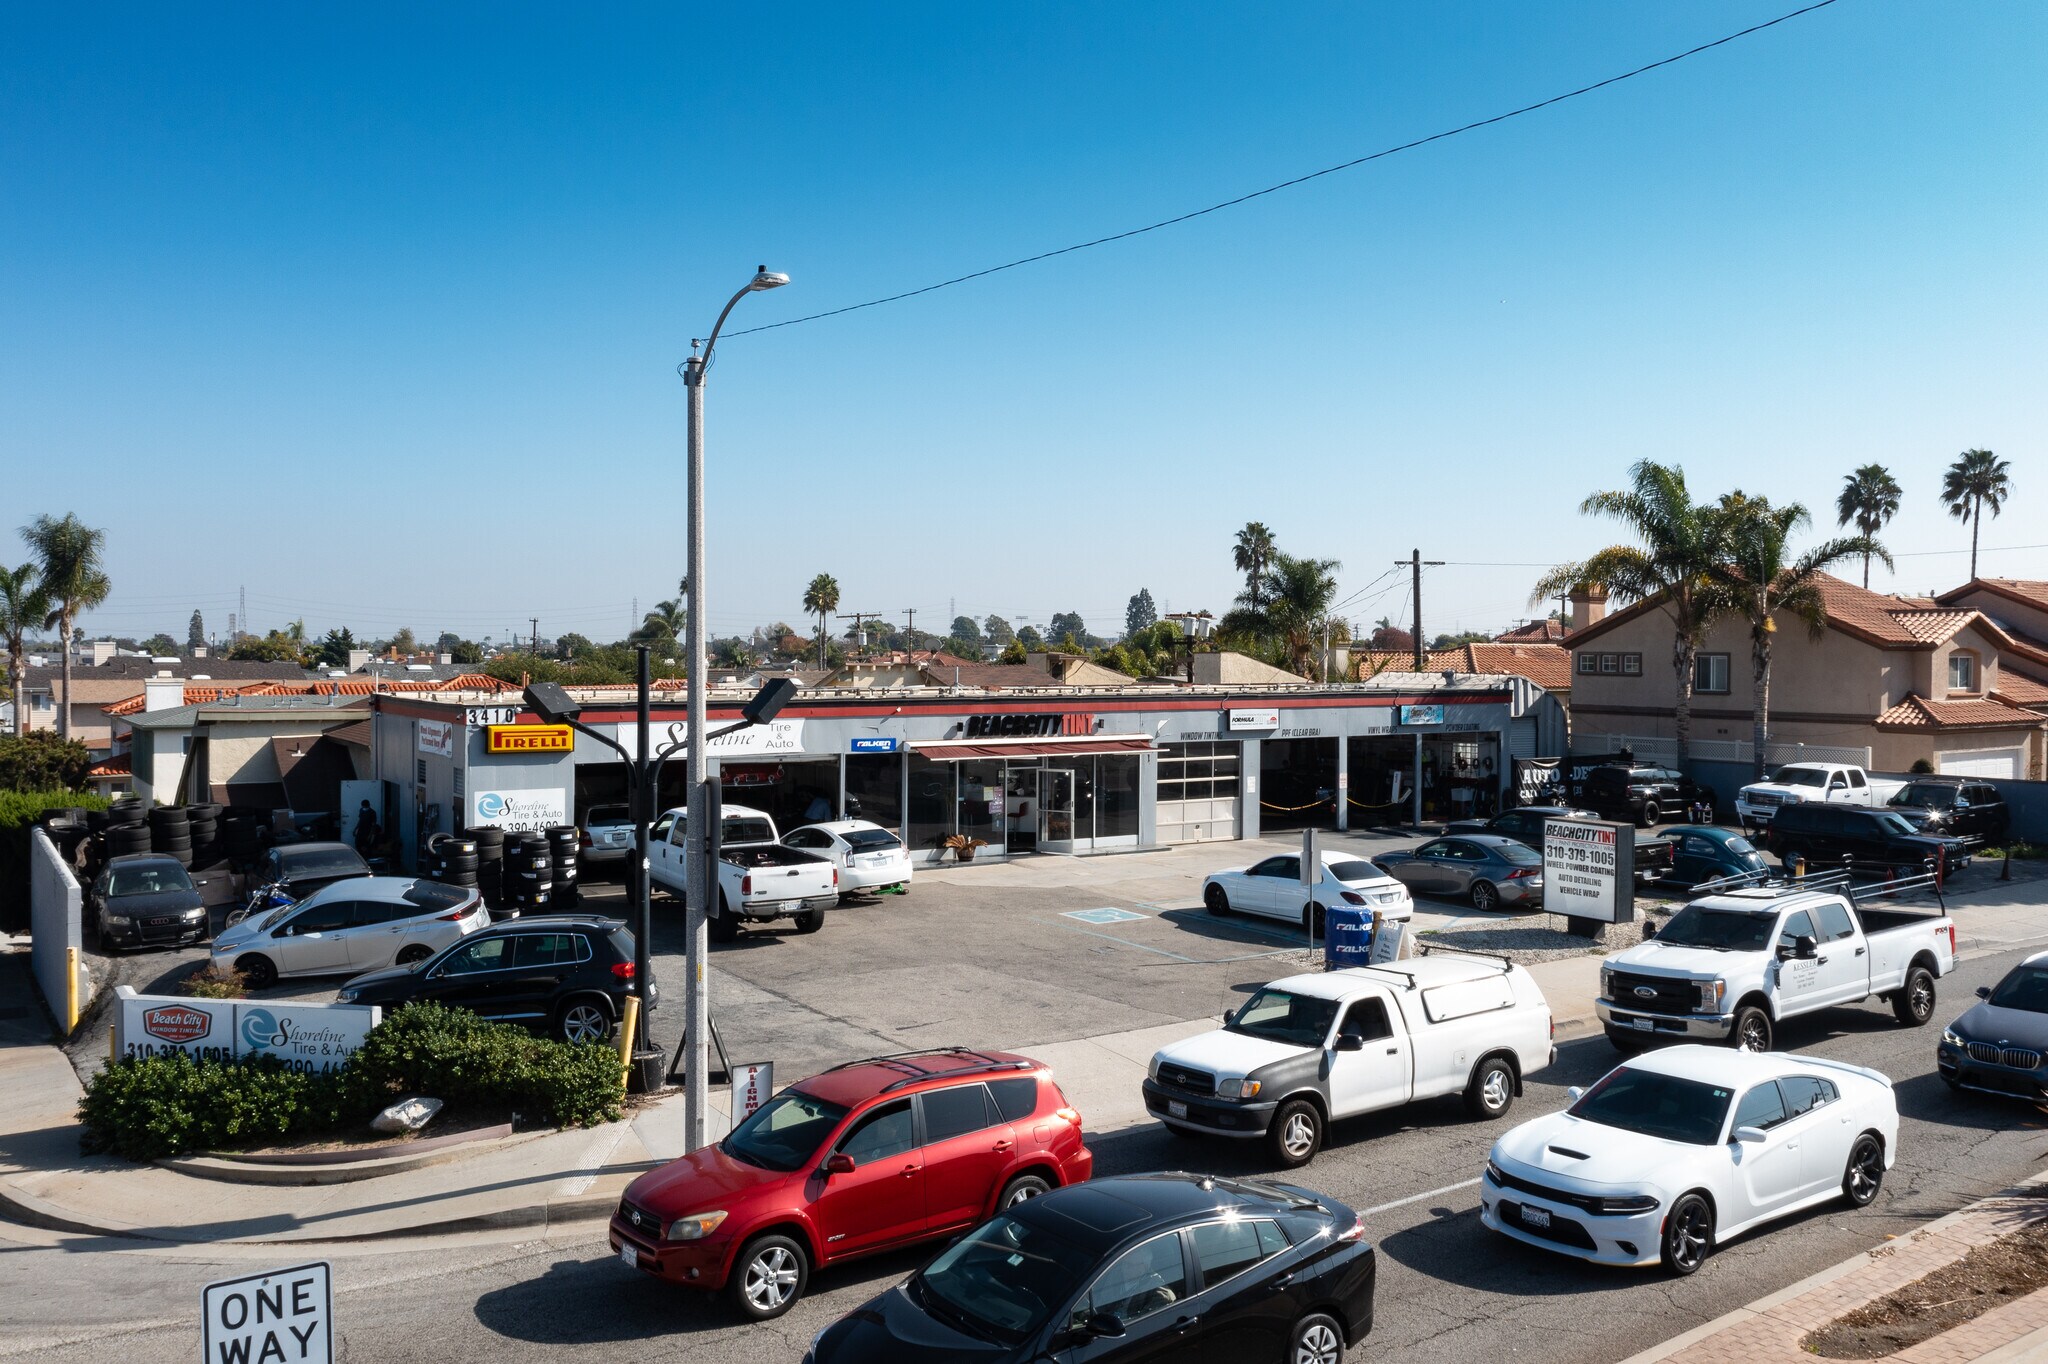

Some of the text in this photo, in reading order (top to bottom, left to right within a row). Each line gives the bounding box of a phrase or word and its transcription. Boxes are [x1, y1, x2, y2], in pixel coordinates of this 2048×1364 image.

[468, 709, 513, 724] 3410
[770, 723, 791, 732] Tire
[1309, 728, 1321, 736] BRA)
[1368, 726, 1398, 734] VINYL WRAPS
[494, 730, 568, 748] PIRELLI
[1180, 731, 1223, 740] WINDOW TINTING
[766, 740, 794, 748] Auto
[1522, 768, 1560, 784] AUTO
[499, 798, 548, 816] Shoreline
[513, 812, 530, 820] Tire
[542, 810, 563, 818] Auto
[1572, 841, 1598, 850] PROTECTION
[1546, 845, 1614, 866] 310-379-1005
[1546, 860, 1614, 876] WHEEL POWDER COATING
[1558, 874, 1602, 887] AUTO DETAILING
[1560, 886, 1600, 898] VEHICLE WRAP
[1794, 960, 1816, 971] KESSLER
[152, 1012, 203, 1029] Beach City
[271, 1018, 346, 1046] Shoreline
[291, 1042, 316, 1055] Tire
[321, 1043, 331, 1056] &
[221, 1278, 316, 1330] ONE
[219, 1320, 318, 1364] WAY
